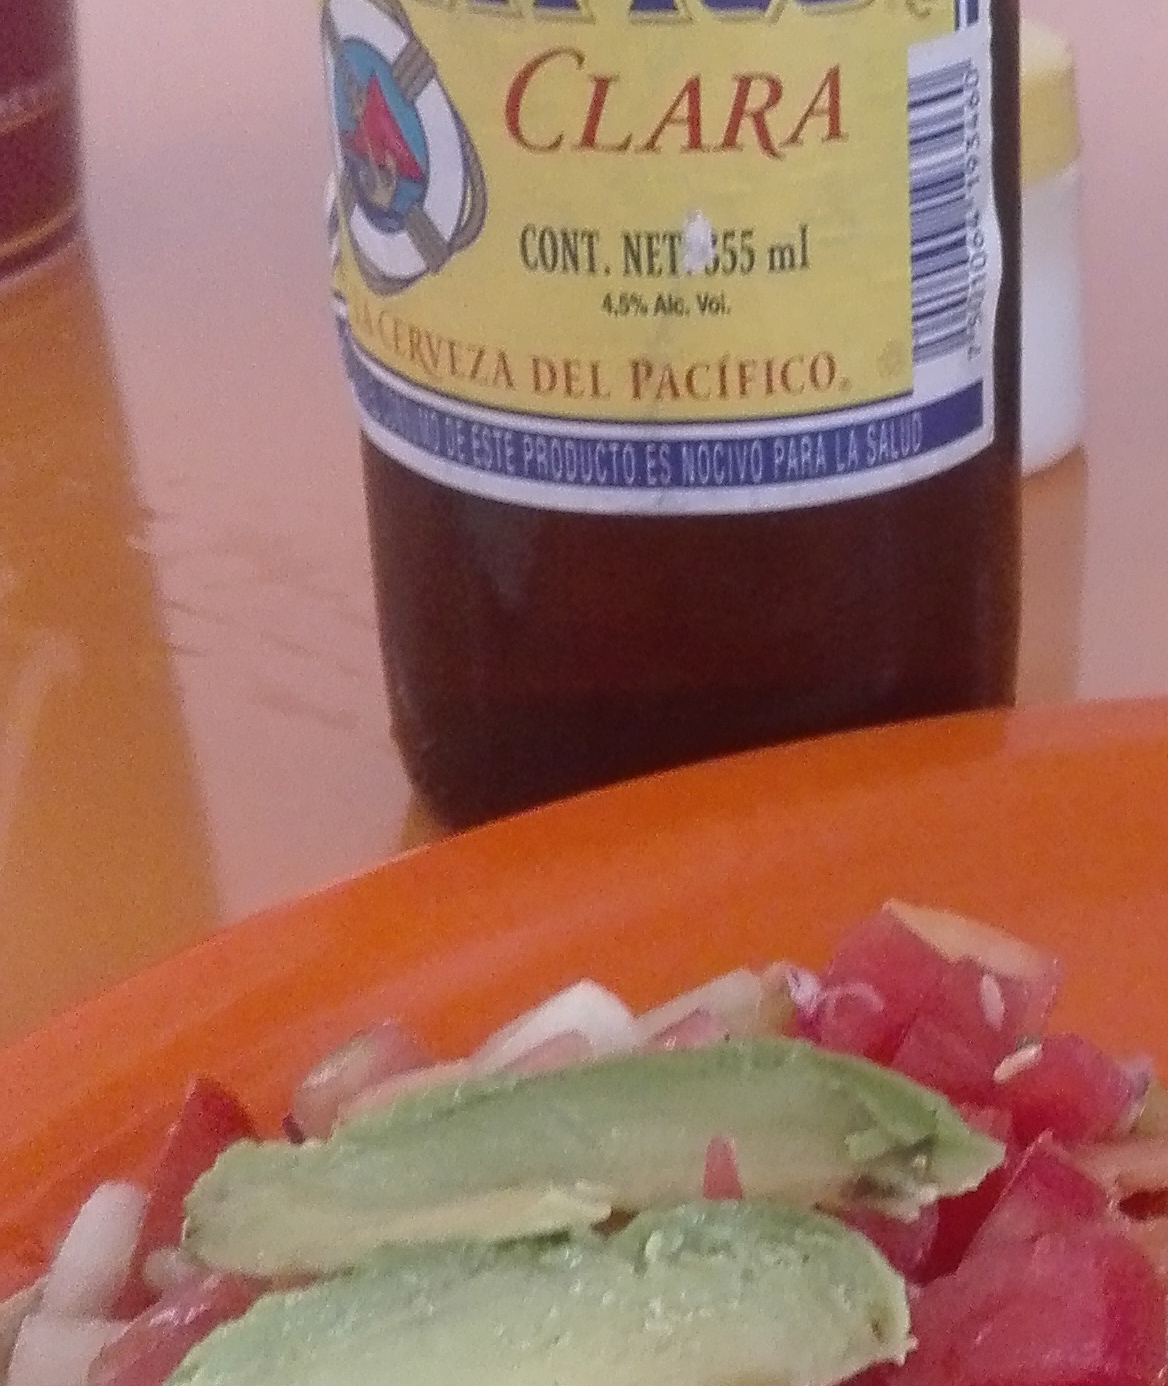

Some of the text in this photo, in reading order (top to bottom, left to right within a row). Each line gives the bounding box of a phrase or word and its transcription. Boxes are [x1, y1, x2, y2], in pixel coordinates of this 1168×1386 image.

[503, 46, 850, 160] CLARA
[520, 222, 611, 275] CONT.
[767, 221, 811, 275] ml
[377, 310, 515, 390] CERVEZA
[531, 350, 612, 400] DEL
[471, 422, 515, 475] ESTE
[522, 434, 637, 486] PRODUCTO
[645, 442, 672, 486] ES
[681, 439, 765, 486] NOCIVO
[772, 432, 827, 479] PARA
[834, 426, 860, 473] LA
[865, 411, 923, 468] SALUD
